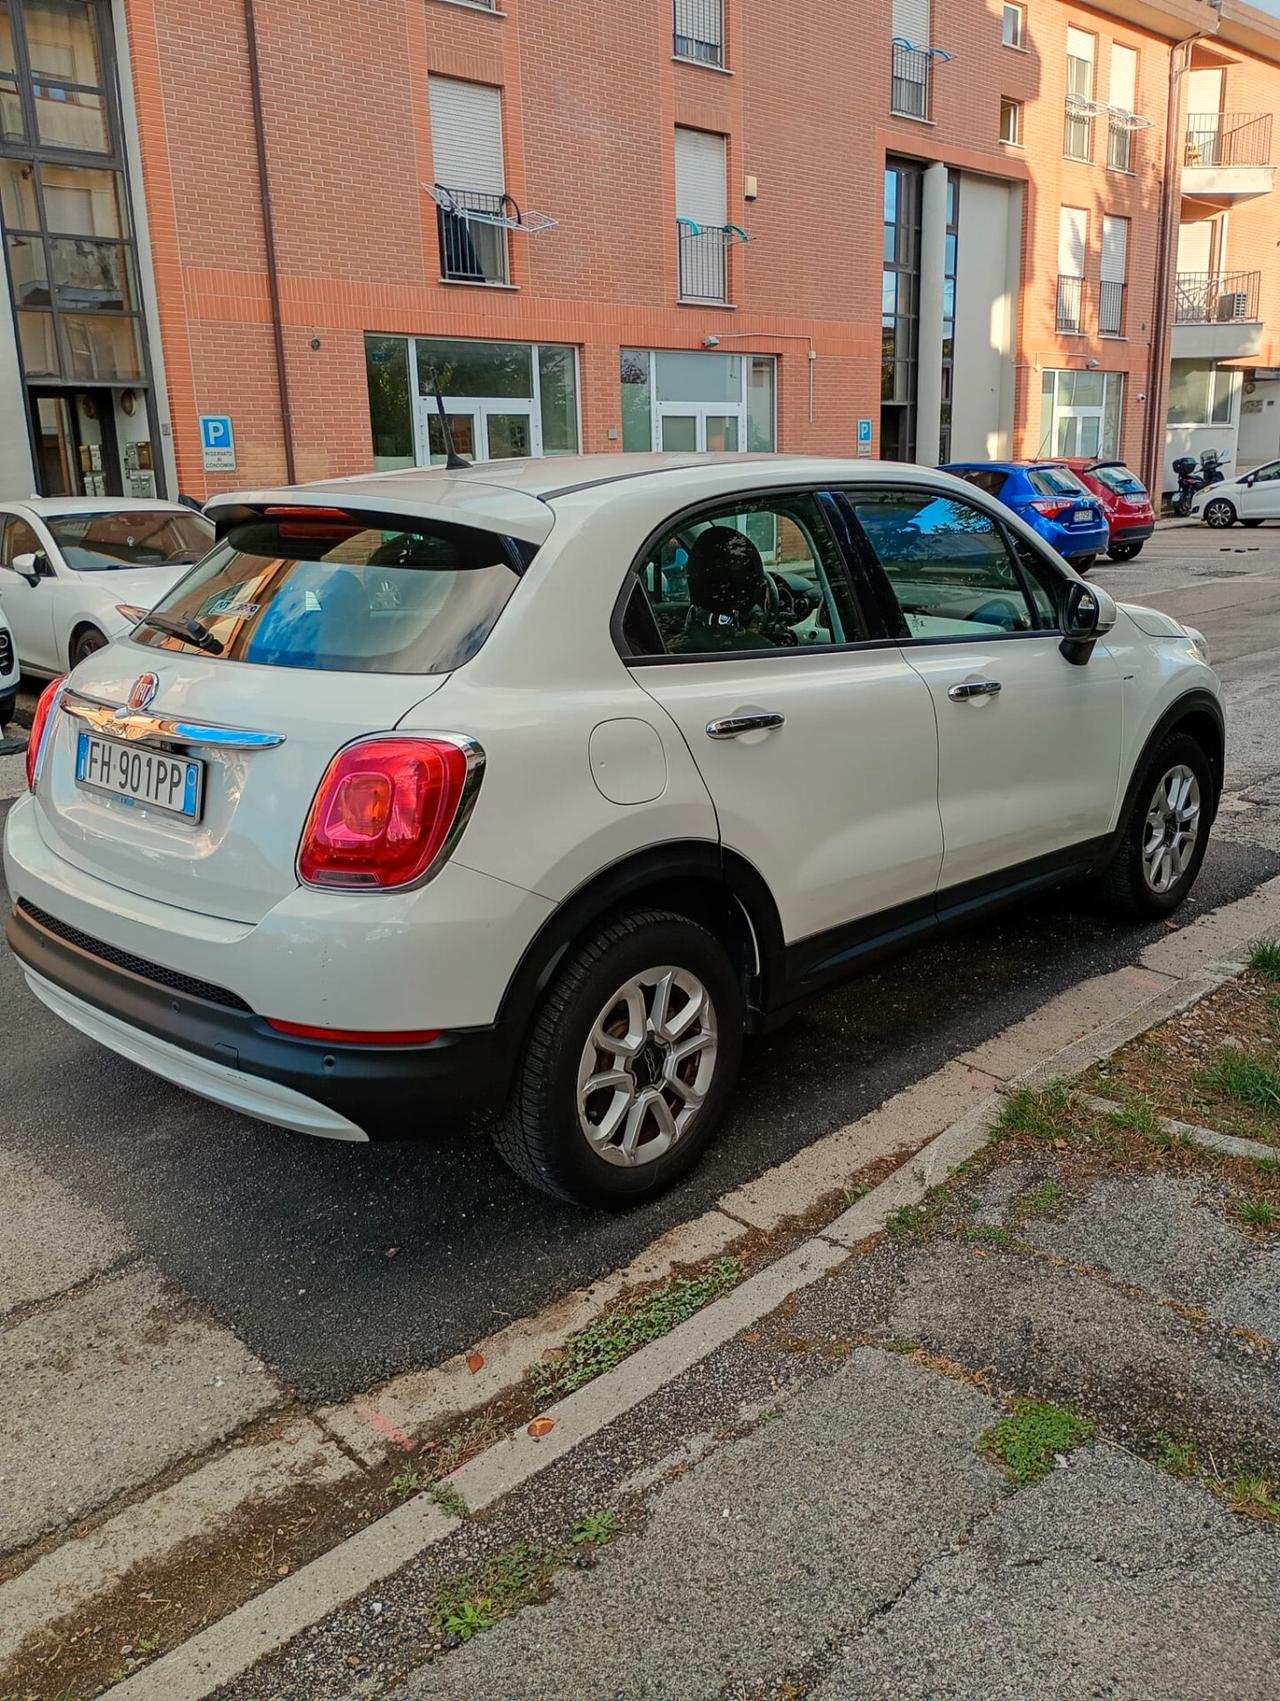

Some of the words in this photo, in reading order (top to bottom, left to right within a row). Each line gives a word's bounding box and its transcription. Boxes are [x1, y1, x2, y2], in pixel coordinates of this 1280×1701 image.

[208, 421, 224, 445] P
[861, 423, 869, 439] P
[89, 741, 112, 784] FH
[119, 750, 182, 804] 901PP
